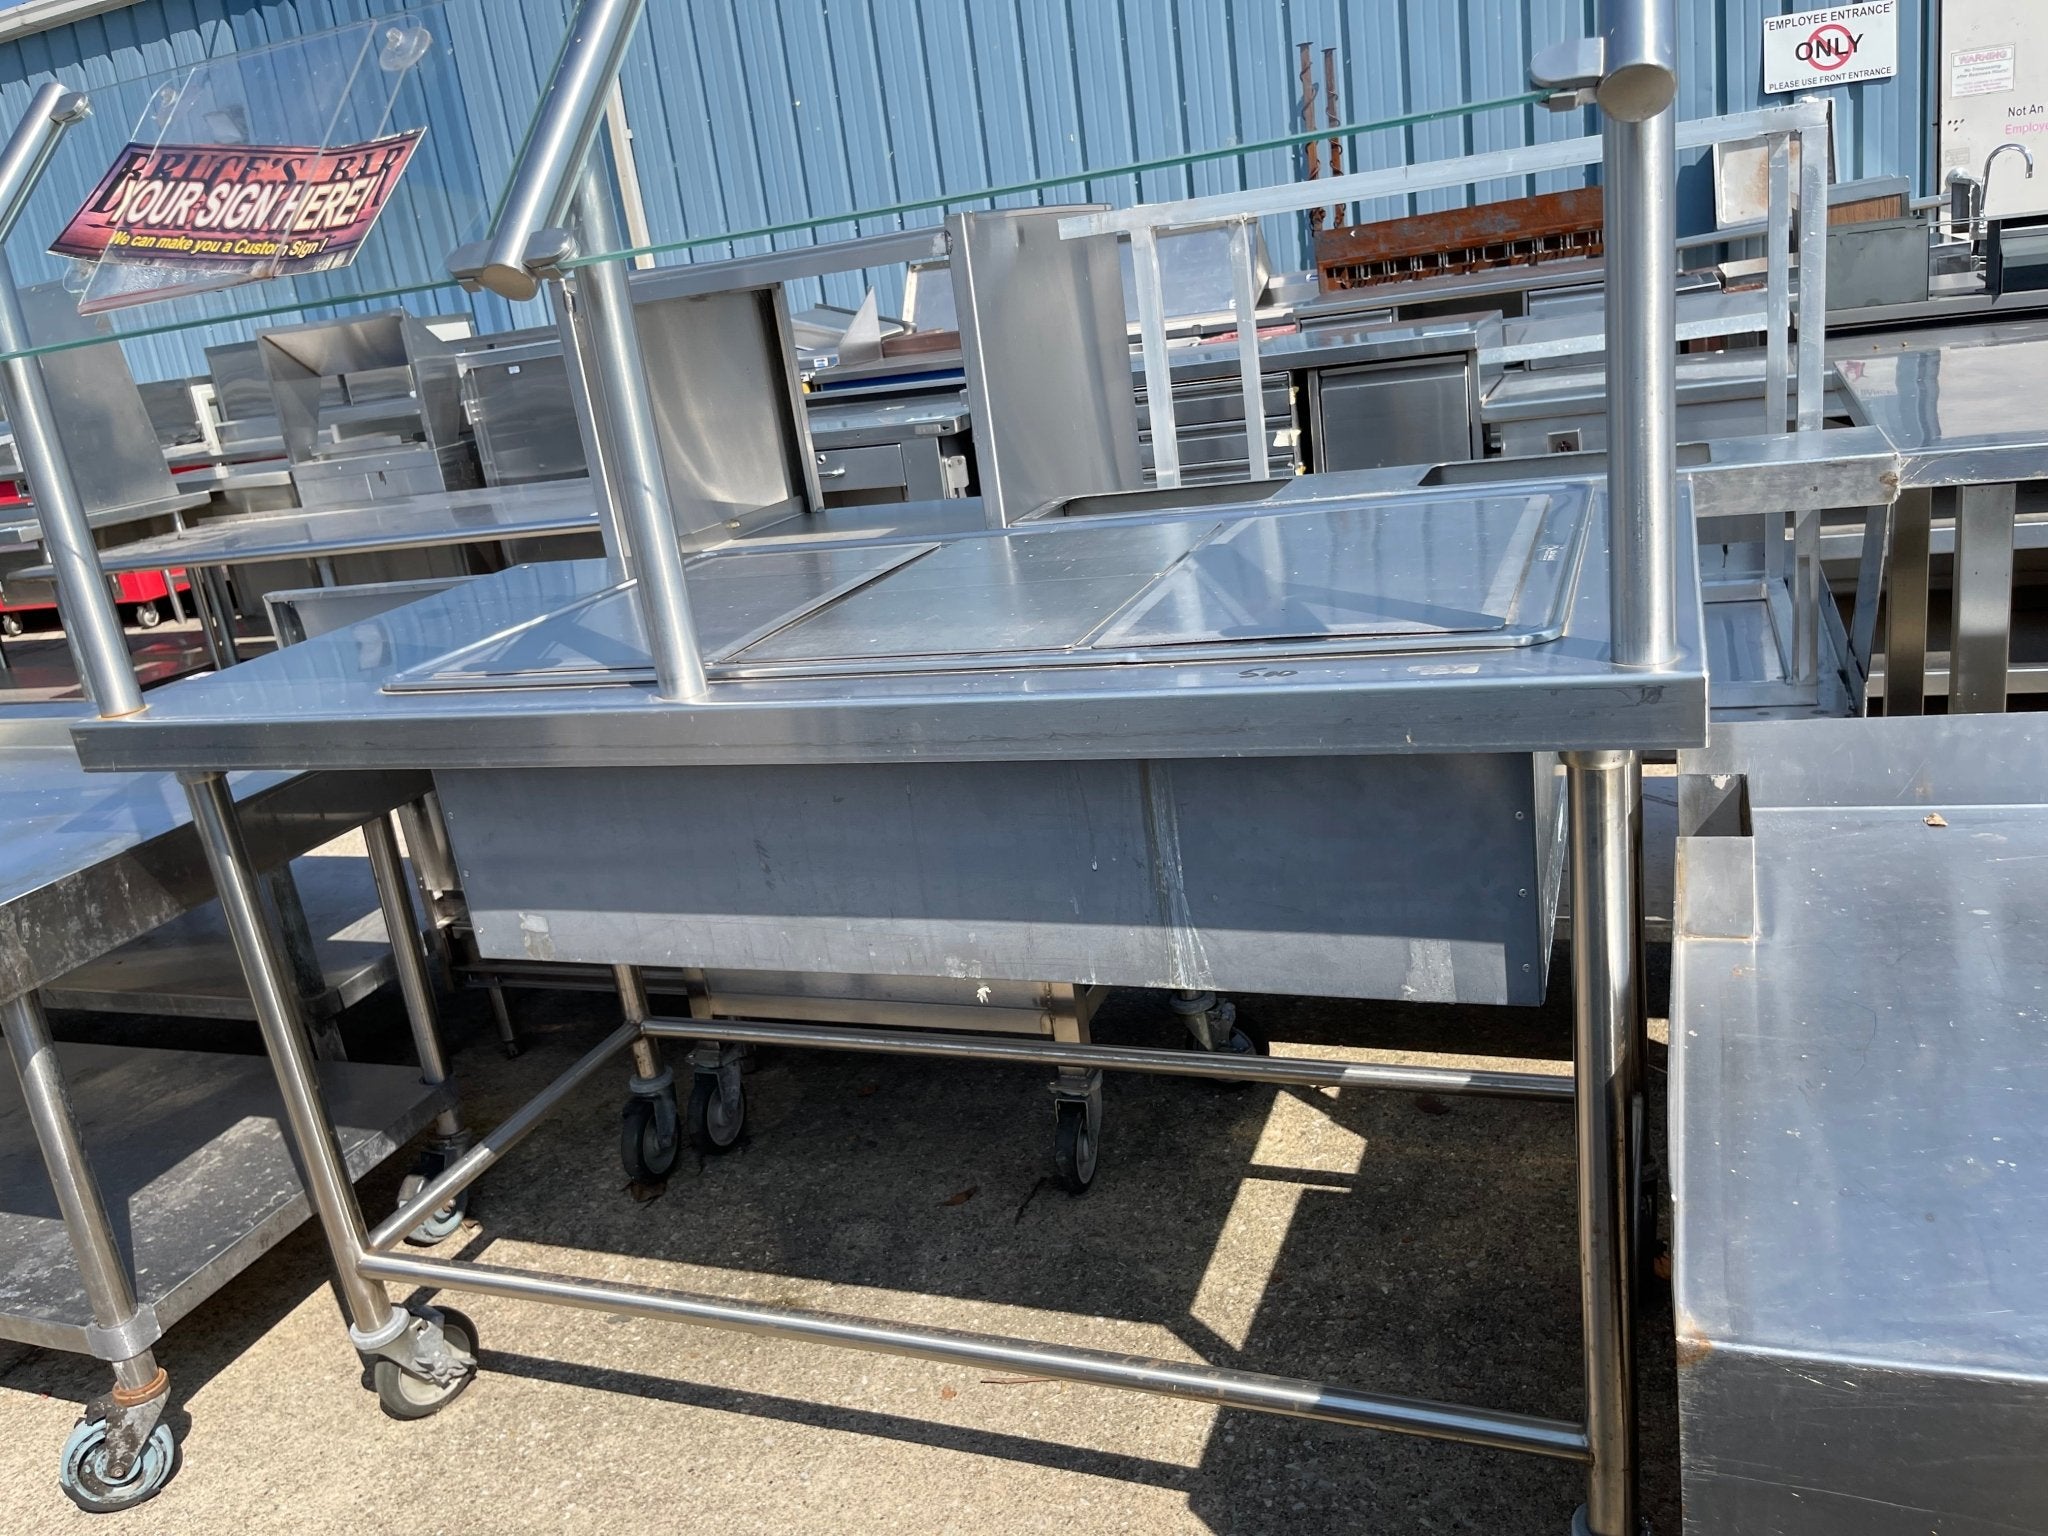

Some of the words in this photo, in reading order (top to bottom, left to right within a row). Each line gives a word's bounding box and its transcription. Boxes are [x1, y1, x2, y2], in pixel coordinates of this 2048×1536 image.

[1795, 33, 1864, 61] ONLY
[1768, 79, 1800, 91] PLEASE
[1801, 76, 1818, 87] USE
[1820, 72, 1847, 84] FRONT
[1848, 66, 1892, 80] ENTRANCE
[2008, 106, 2026, 117] Not
[2029, 104, 2044, 114] An
[110, 178, 205, 227] YOUR
[193, 181, 285, 230] SIGN
[271, 175, 379, 231] HERE!
[110, 230, 130, 245] We
[130, 235, 156, 248] can
[156, 236, 193, 251] make
[191, 240, 222, 255] you
[221, 242, 233, 253] a
